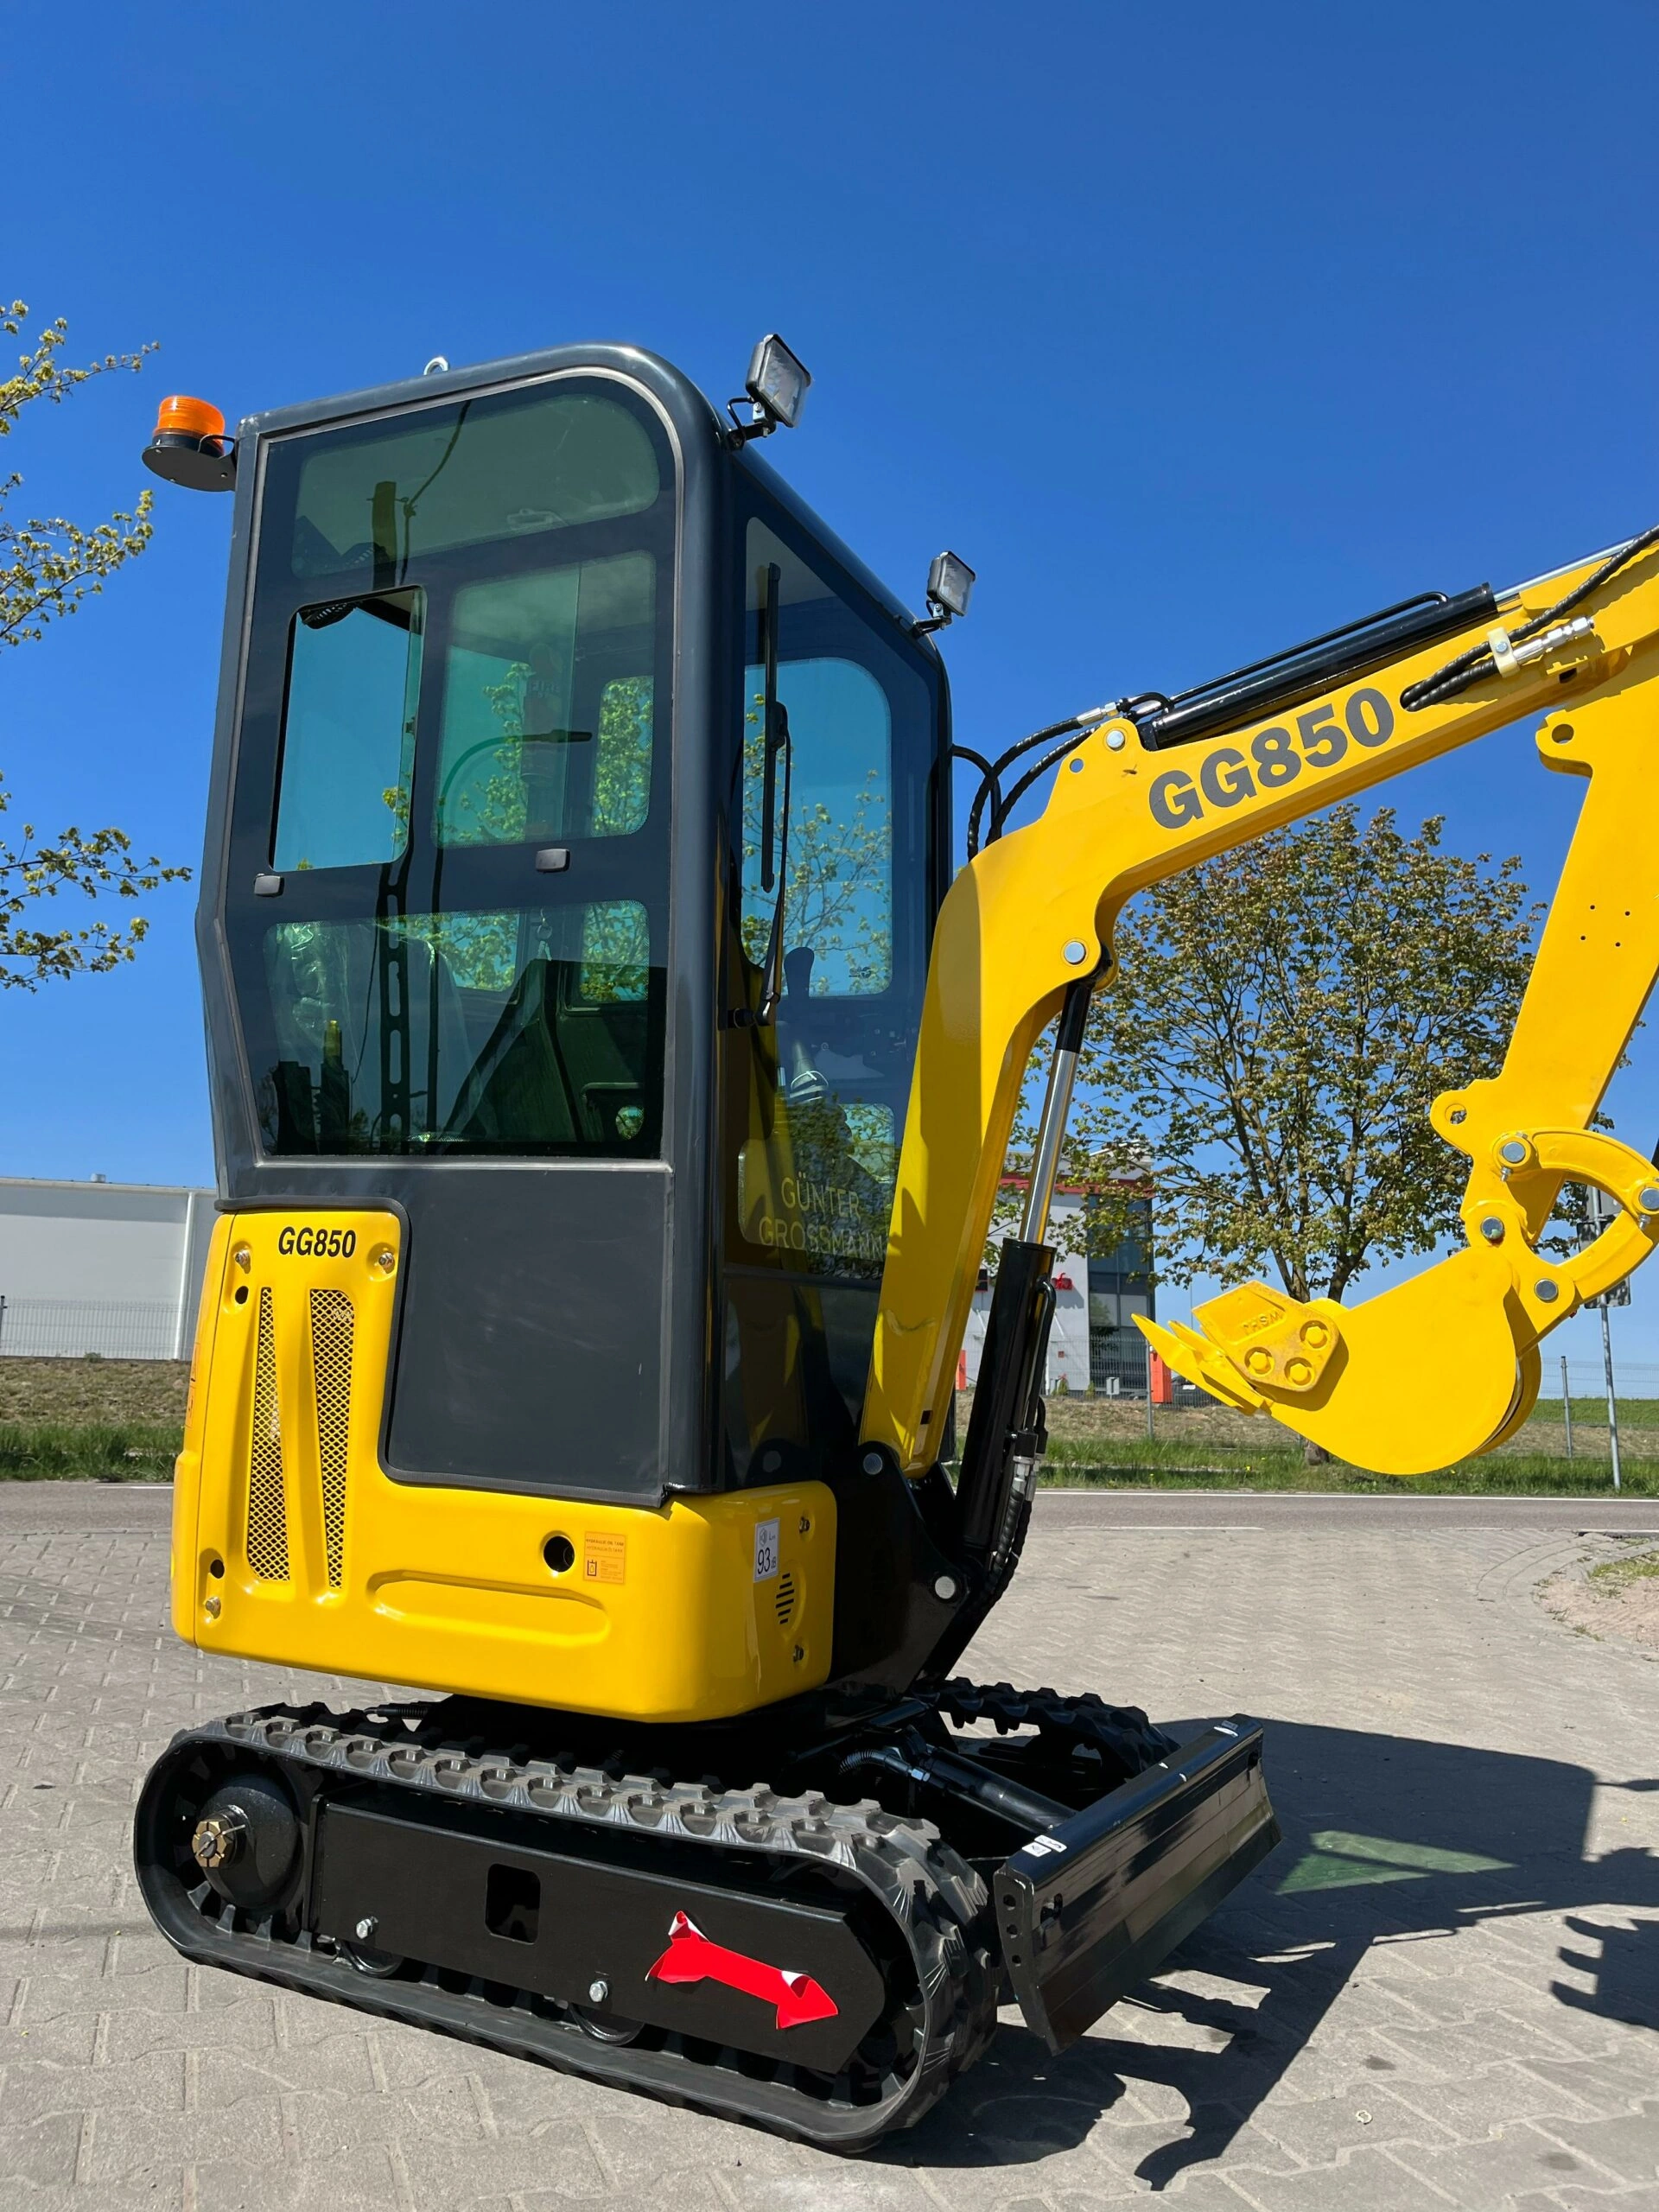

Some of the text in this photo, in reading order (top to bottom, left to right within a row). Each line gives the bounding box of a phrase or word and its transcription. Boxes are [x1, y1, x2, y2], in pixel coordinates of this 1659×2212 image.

[1149, 688, 1395, 830] GG850
[781, 1171, 861, 1224] GÜNTER
[278, 1226, 356, 1258] GG850
[759, 1217, 884, 1261] GROSSMANN
[758, 1547, 771, 1574] 93
